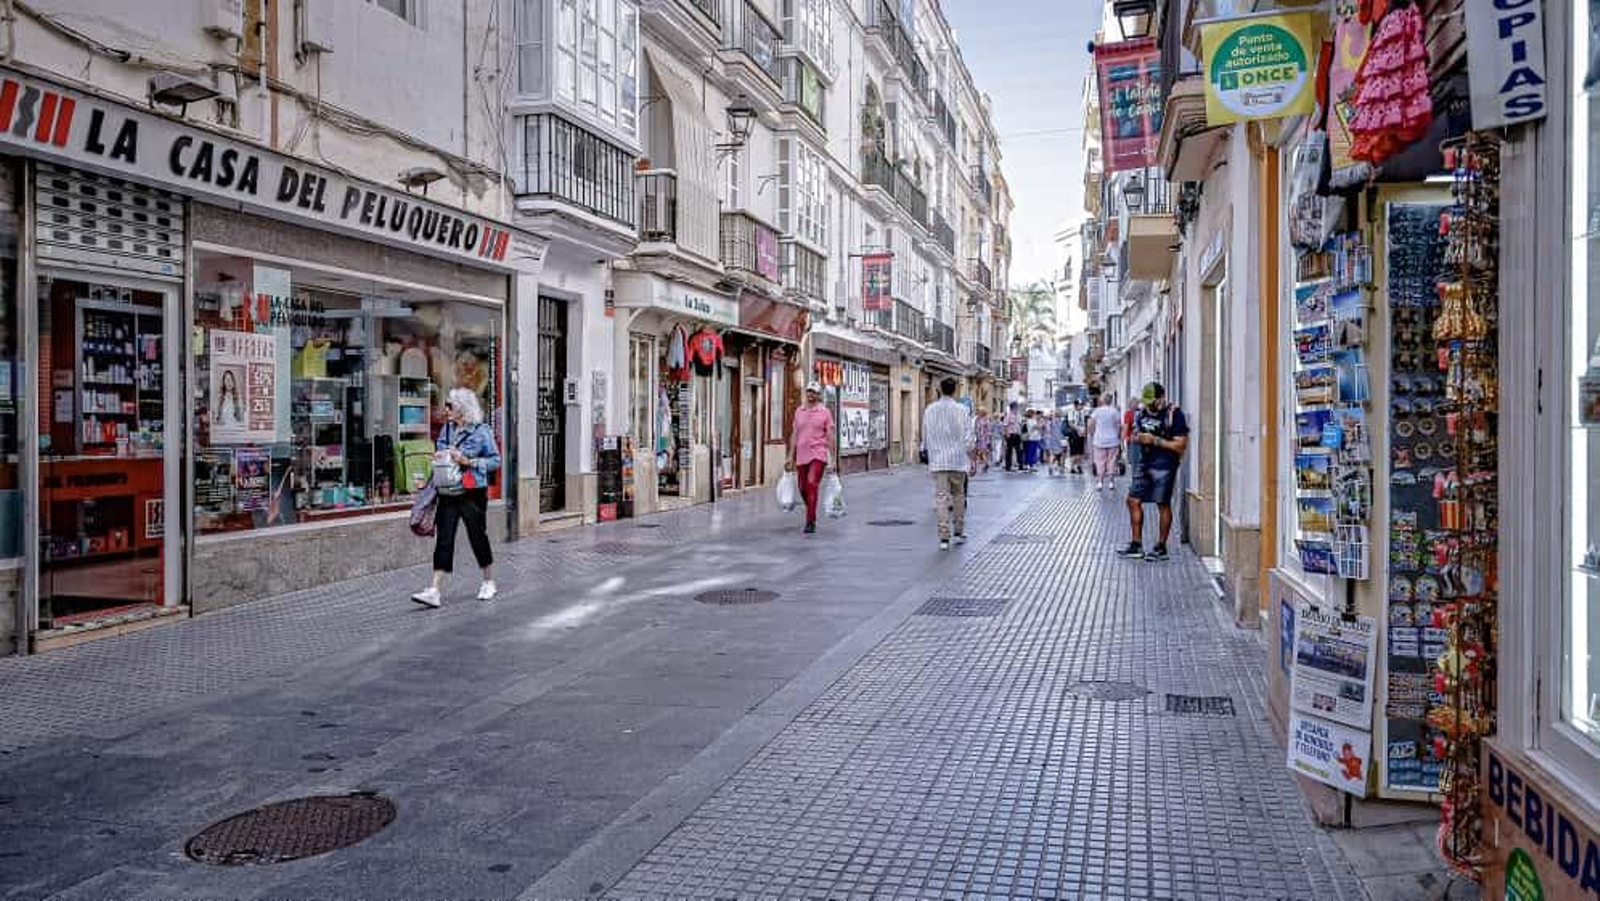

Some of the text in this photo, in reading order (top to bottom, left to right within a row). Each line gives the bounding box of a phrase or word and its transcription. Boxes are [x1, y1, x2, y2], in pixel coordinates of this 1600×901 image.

[1239, 33, 1273, 46] Punto
[1231, 43, 1282, 57] de venta
[1225, 51, 1290, 69] autorizado
[1242, 66, 1295, 85] ONCE
[84, 108, 479, 252] LA CASA DEL PELUQUERO
